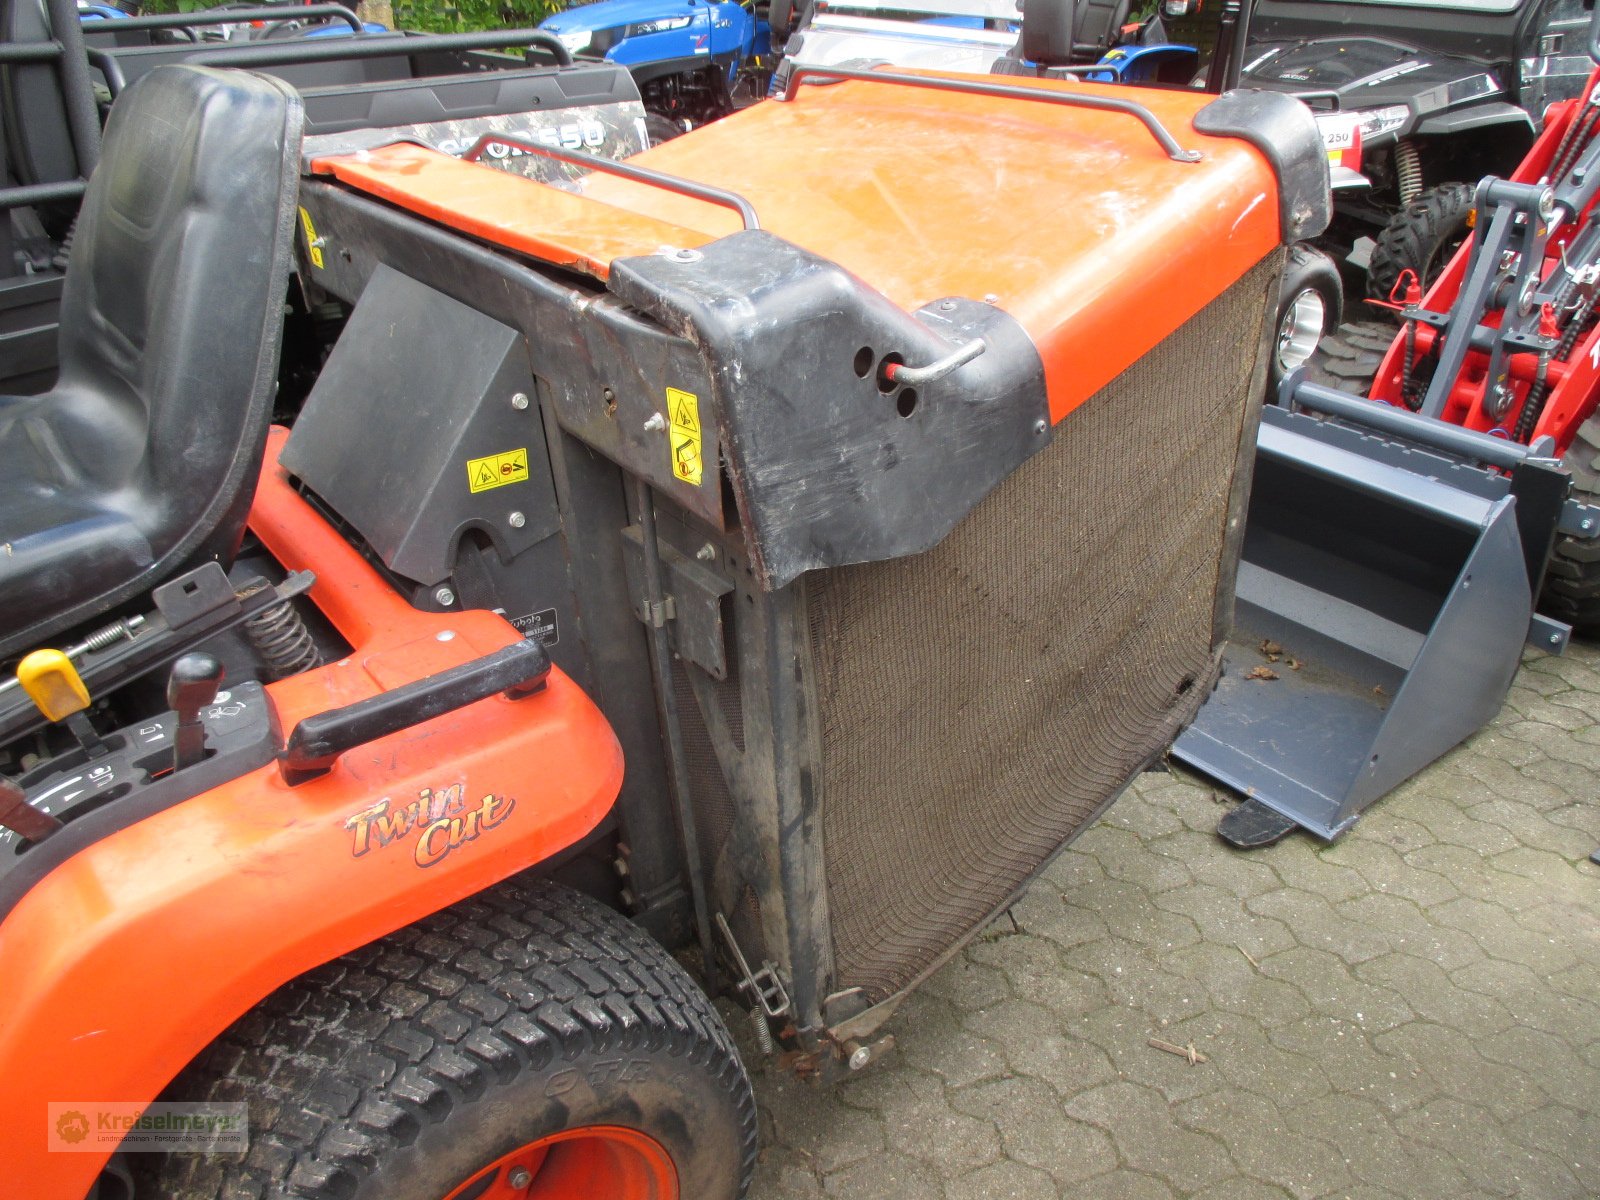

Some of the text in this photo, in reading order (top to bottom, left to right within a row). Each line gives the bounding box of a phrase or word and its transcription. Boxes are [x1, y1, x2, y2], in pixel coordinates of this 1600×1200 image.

[1328, 133, 1349, 144] 250
[511, 615, 541, 629] ubota
[345, 784, 464, 857] Twin
[414, 793, 516, 868] Cut
